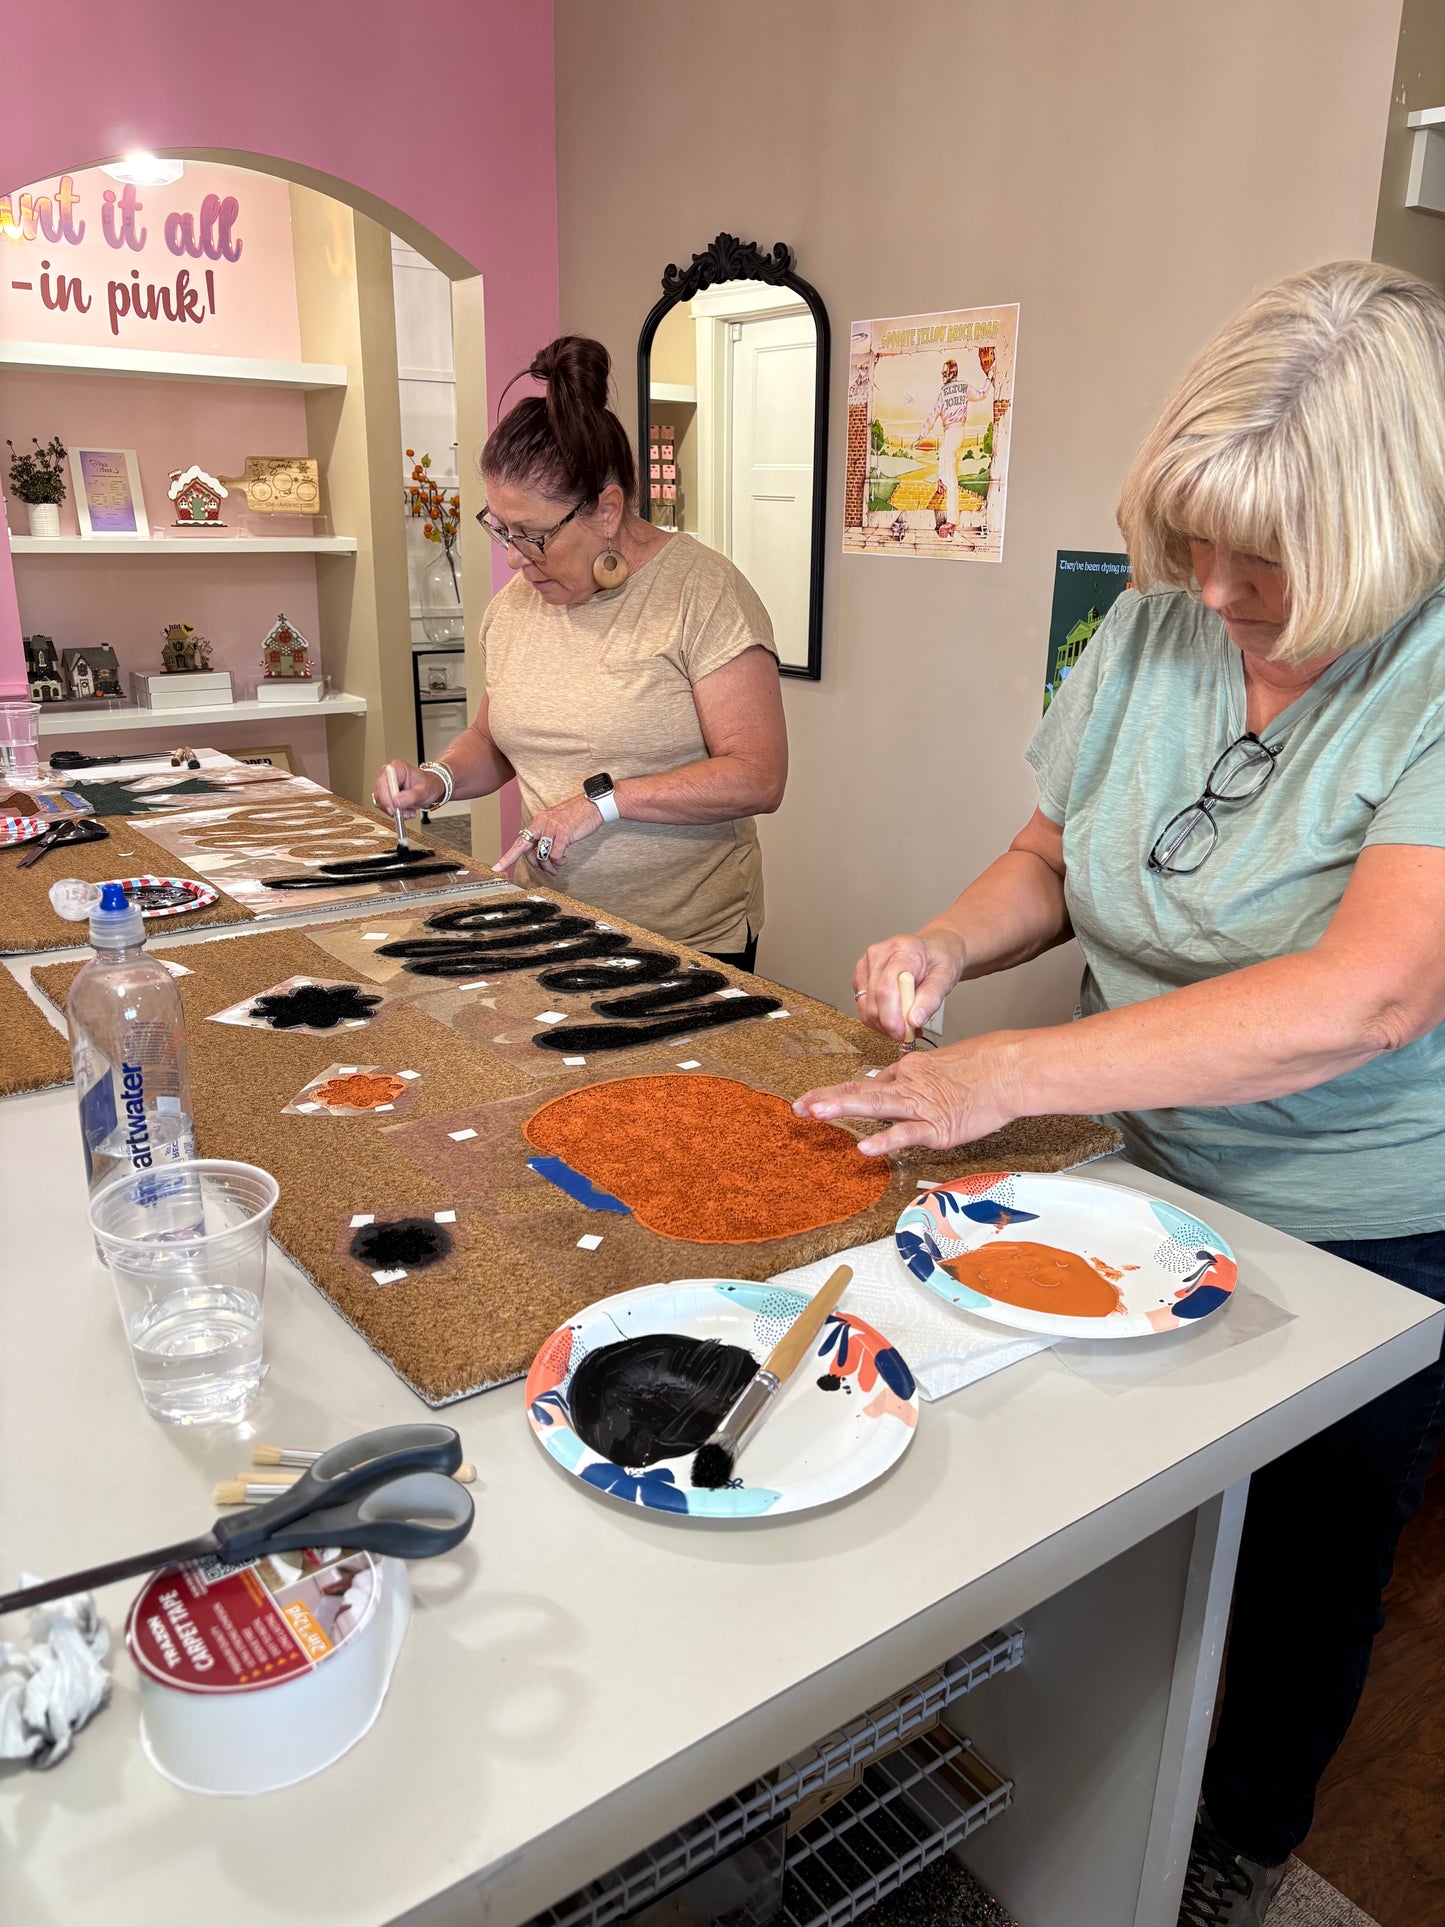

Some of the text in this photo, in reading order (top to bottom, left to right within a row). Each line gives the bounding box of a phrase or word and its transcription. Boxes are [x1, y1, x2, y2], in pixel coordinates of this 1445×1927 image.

[101, 183, 147, 252] it
[164, 193, 243, 262] all
[107, 269, 216, 335] pink!
[880, 320, 999, 348] GOODBYE YELLOW BRICK ROAD
[943, 383, 968, 397] ELTON
[944, 395, 966, 409] JOHN
[1060, 560, 1084, 572] They've
[1084, 561, 1100, 572] been
[1101, 562, 1120, 574] dying
[1120, 563, 1127, 573] to
[158, 1589, 189, 1625] TAPE
[147, 1615, 181, 1669] TRAZON
[174, 1621, 215, 1672] CARPET
